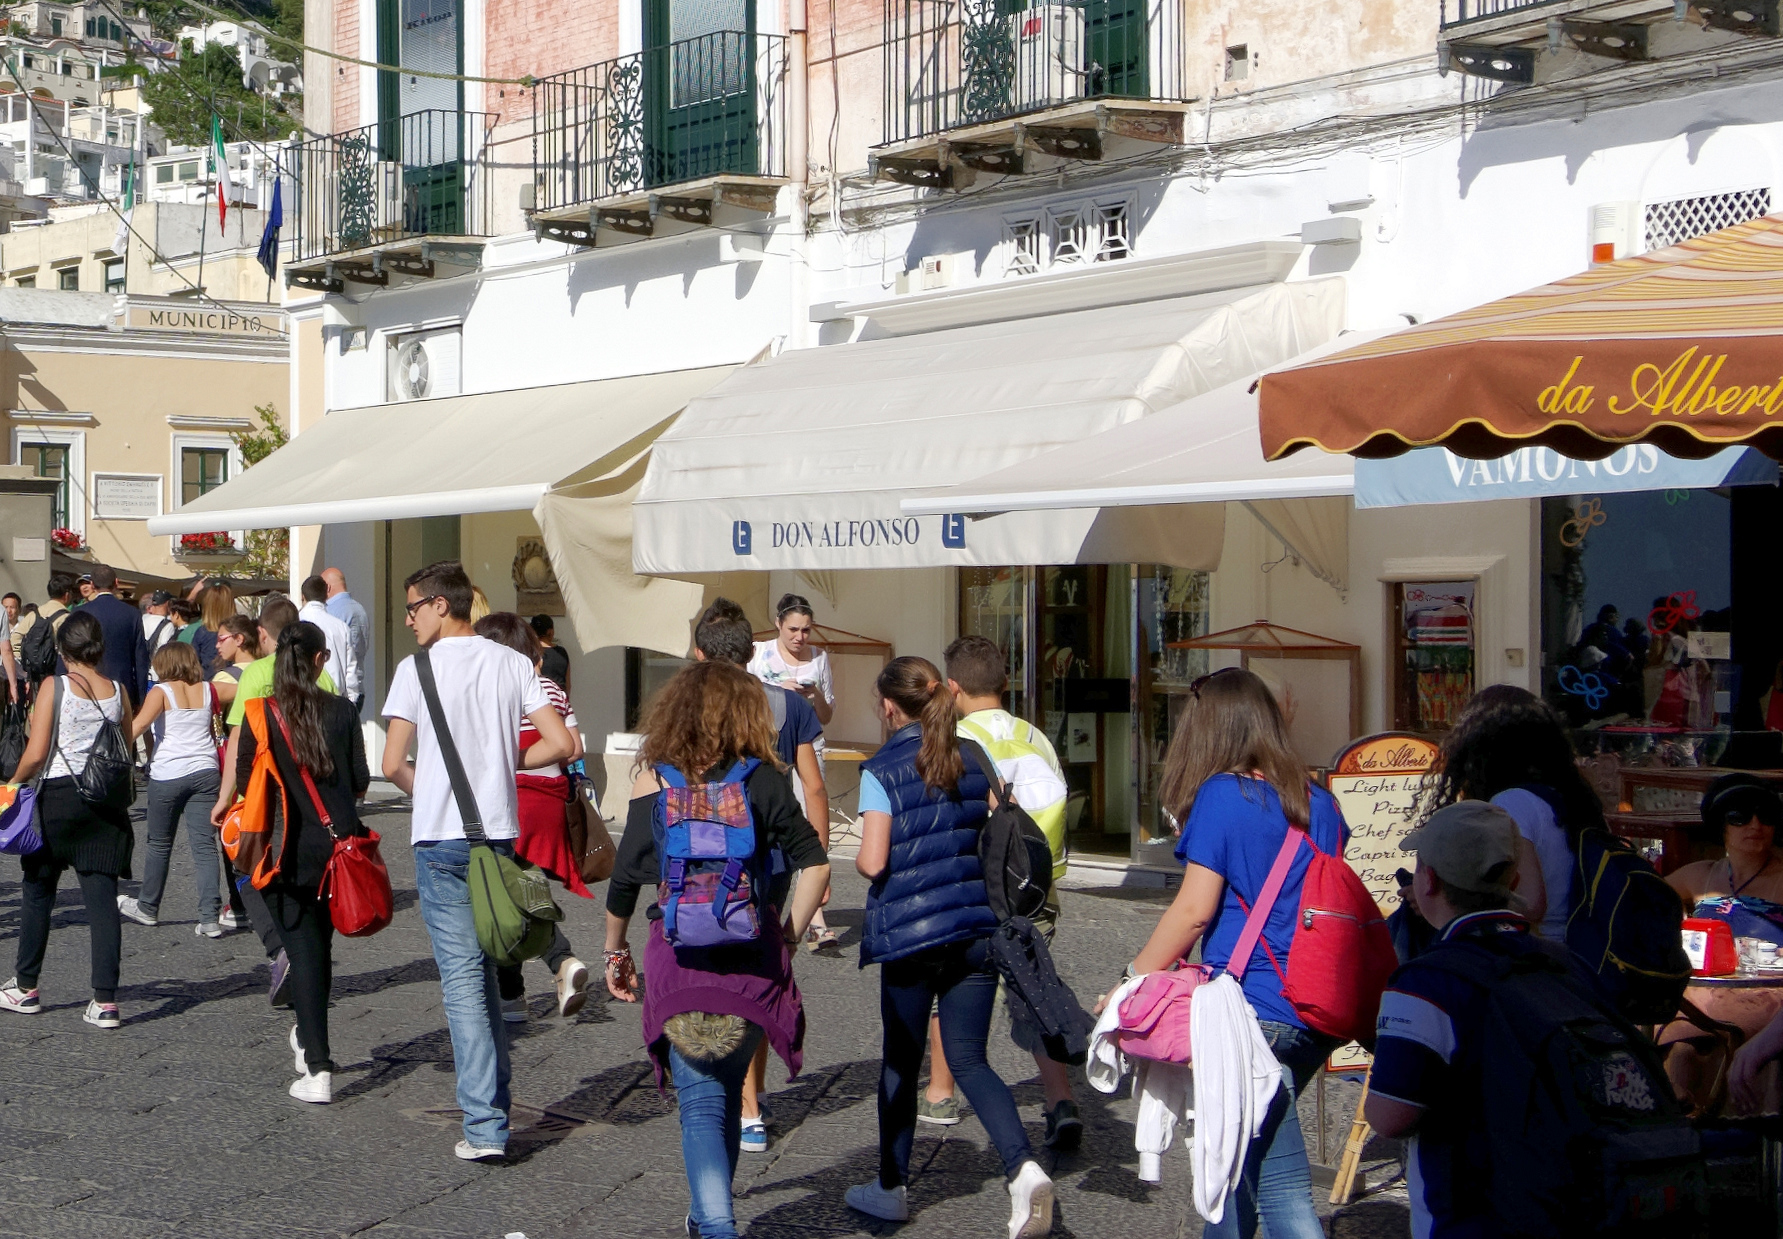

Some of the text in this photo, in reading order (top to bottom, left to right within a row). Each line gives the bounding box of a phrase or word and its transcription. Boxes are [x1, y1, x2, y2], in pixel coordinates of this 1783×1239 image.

[149, 310, 262, 332] MUNICIPIO
[1537, 355, 1595, 414] da
[772, 517, 920, 548] DON ALFONSO
[1362, 743, 1428, 769] da Alberto
[1343, 778, 1397, 796] Light
[1350, 822, 1396, 841] Chef
[1344, 846, 1397, 863] Capri
